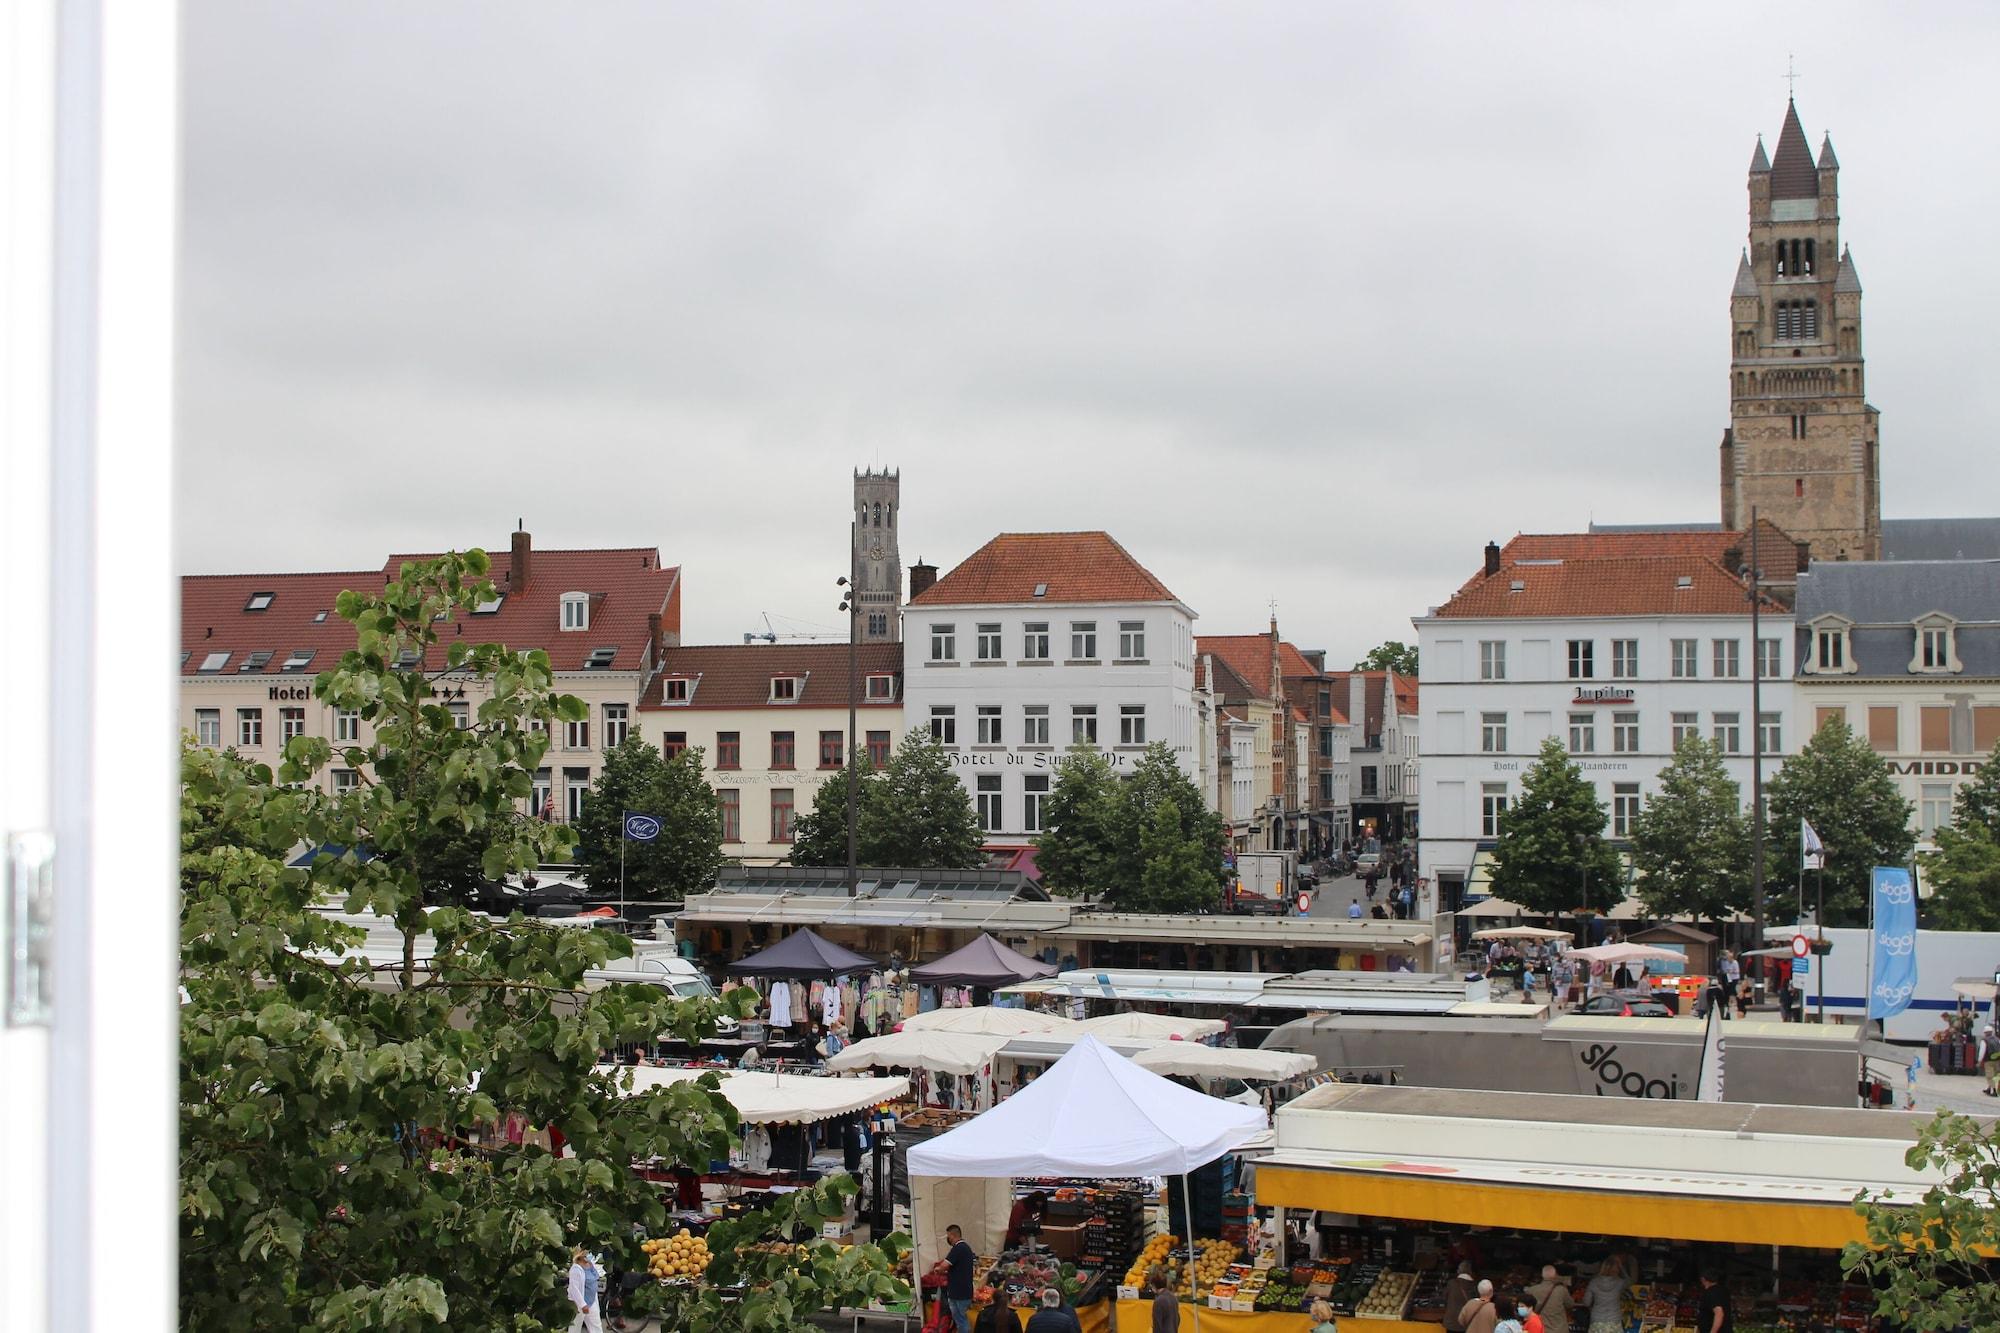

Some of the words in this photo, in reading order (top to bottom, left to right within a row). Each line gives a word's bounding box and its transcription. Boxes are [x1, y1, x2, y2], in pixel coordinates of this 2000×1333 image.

[269, 686, 310, 700] Hotel
[1575, 686, 1635, 701] Jupiler
[948, 752, 995, 767] Hotel
[1006, 752, 1024, 766] du
[1033, 752, 1071, 768] Sing
[1493, 762, 1519, 771] Hotel
[786, 770, 828, 785] Hanz
[1580, 1044, 1678, 1100] sloggi
[1518, 1168, 1748, 1187] Groenten
